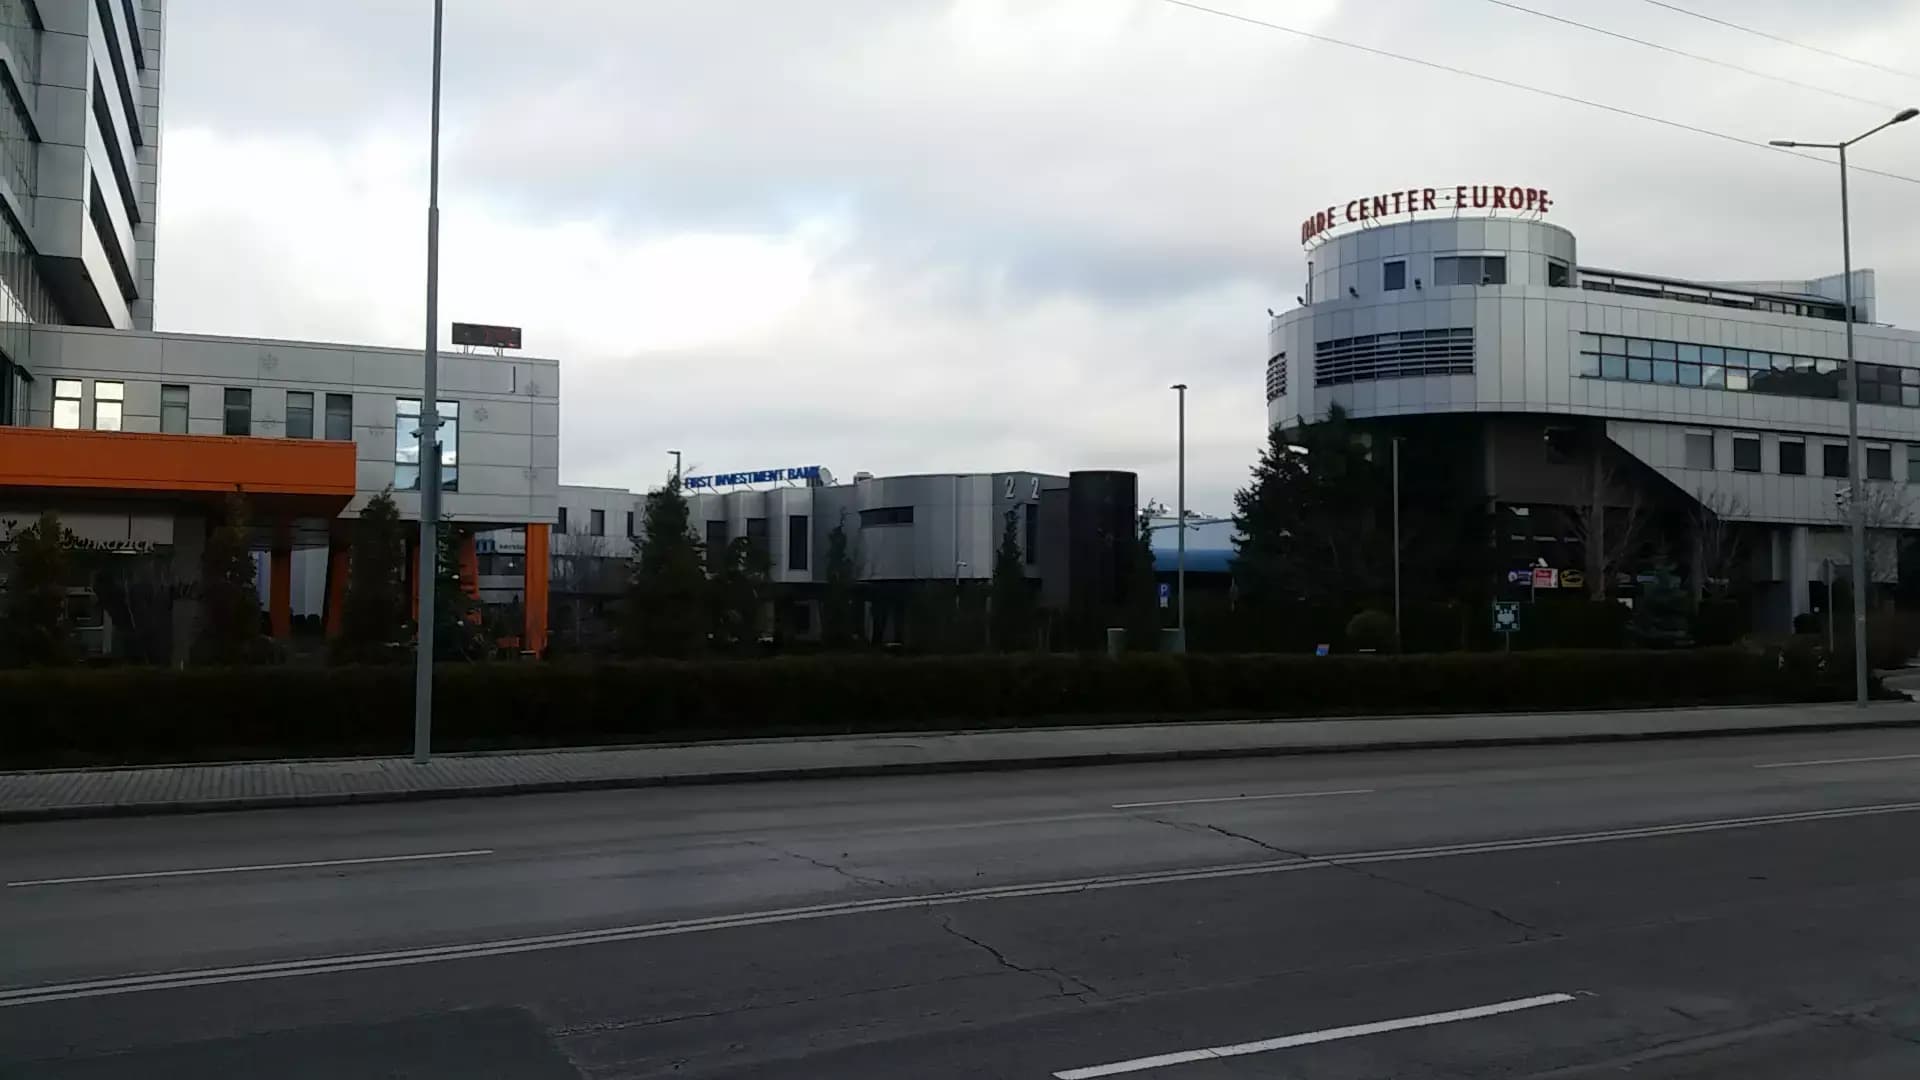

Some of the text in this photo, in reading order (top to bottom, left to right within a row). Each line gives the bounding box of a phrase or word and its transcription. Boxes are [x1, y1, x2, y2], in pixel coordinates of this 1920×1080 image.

[1346, 188, 1436, 222] CENTER
[685, 466, 819, 489] FIRST INVESTMENT BANK
[1160, 584, 1169, 595] P
